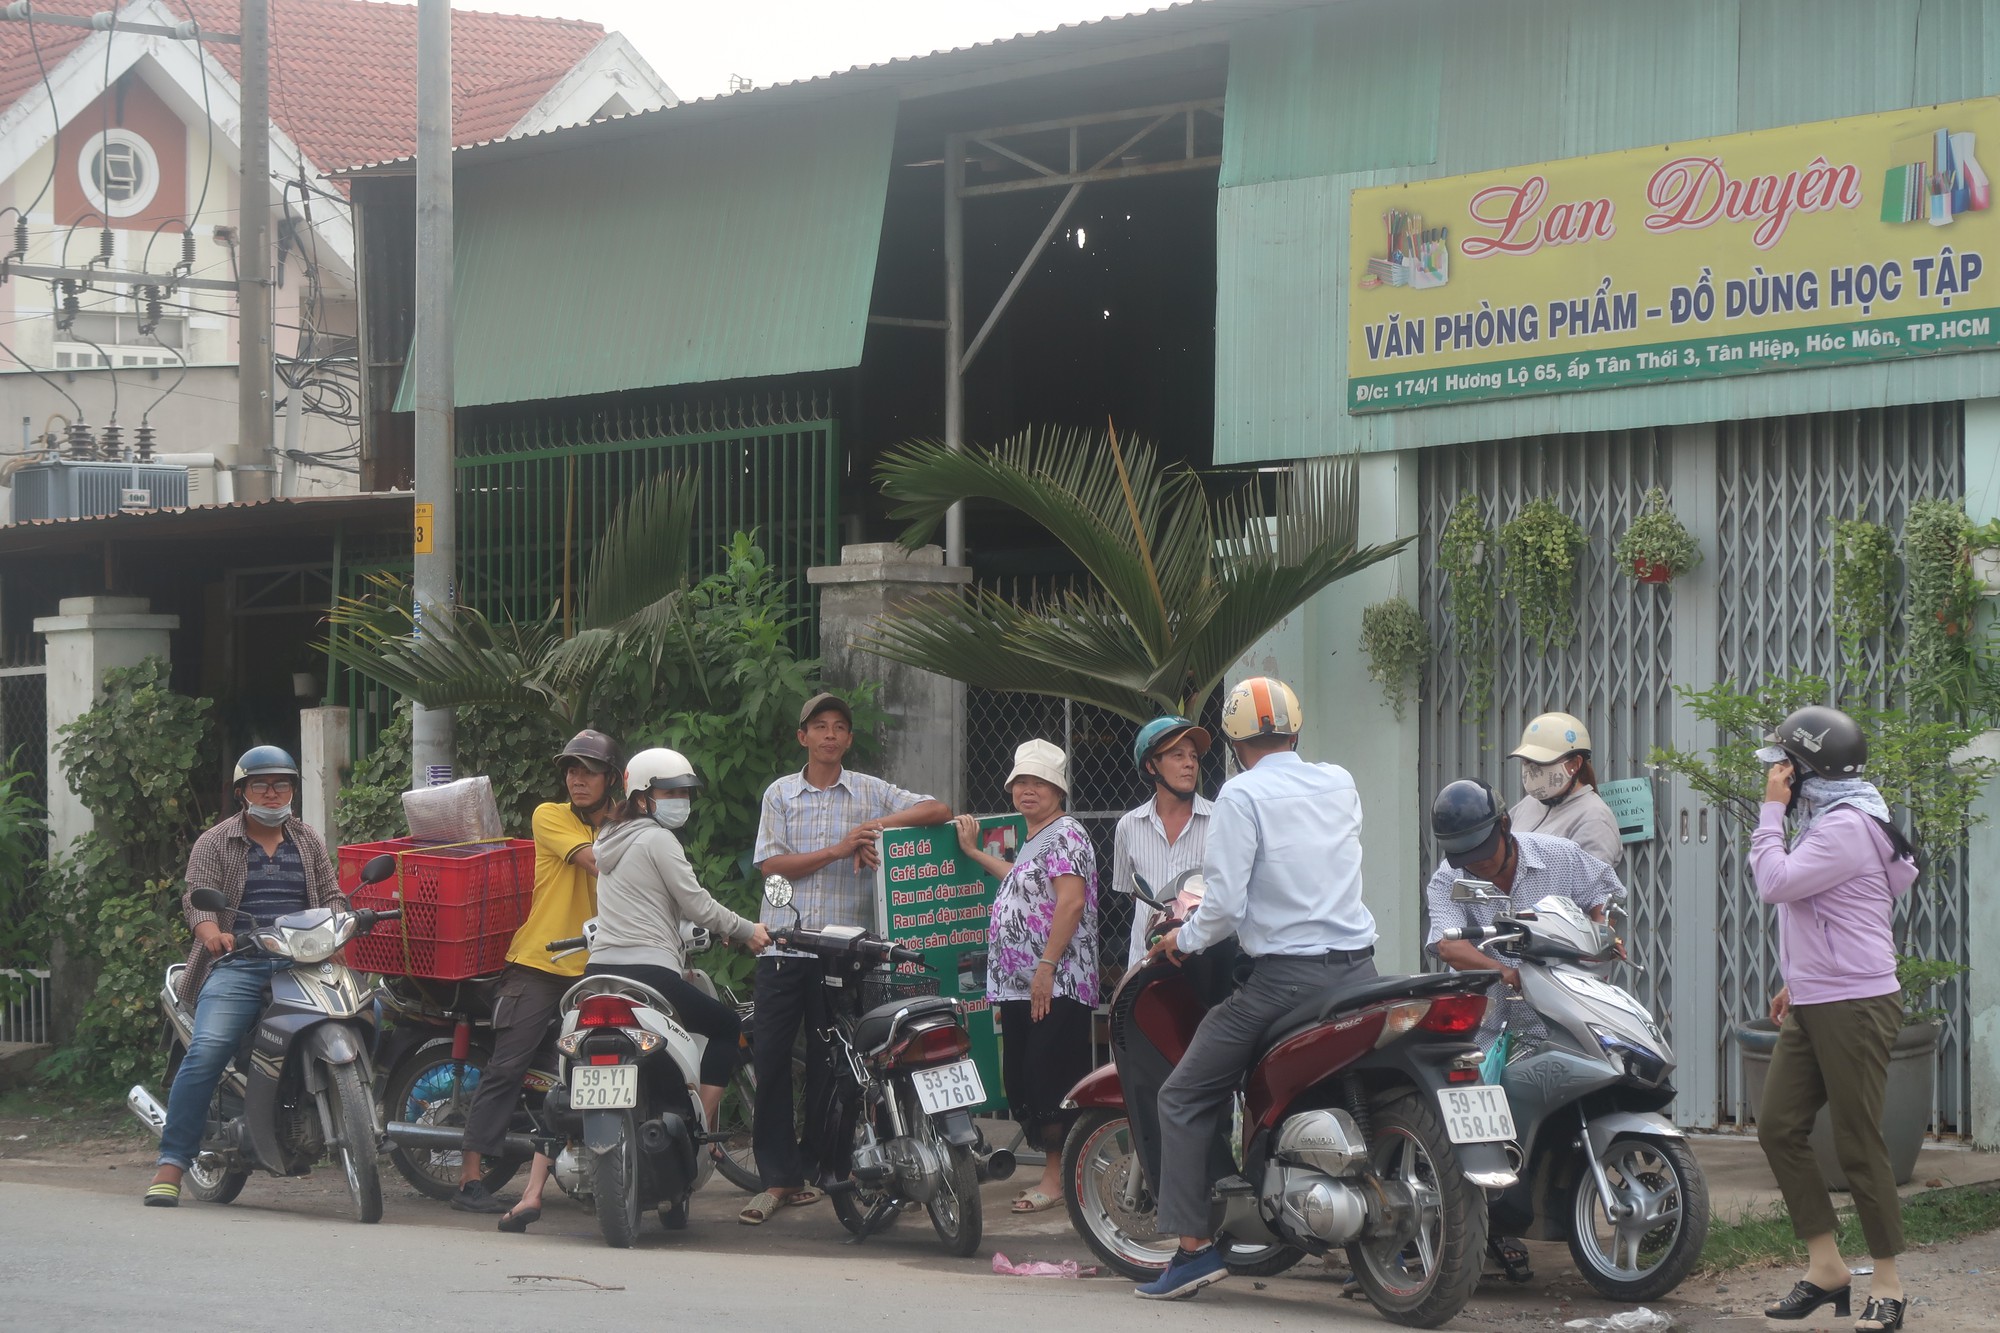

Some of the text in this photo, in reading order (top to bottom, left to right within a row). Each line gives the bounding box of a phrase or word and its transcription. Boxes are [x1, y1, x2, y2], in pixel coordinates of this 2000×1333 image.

[1461, 156, 1861, 258] Lan Duyên
[1365, 313, 1425, 360] VĂN
[1434, 300, 1538, 352] PHÒNG
[1548, 276, 1638, 338] PHẨM
[1670, 267, 1714, 325] ĐỒ
[1725, 266, 1820, 319] DÙNG
[1830, 261, 1902, 315] HỌC
[1912, 246, 1983, 307] TẬP
[1356, 317, 1990, 401] Đ/c: 174/1 Hương Lộ 65, ấp Tân Thới 3, Tân Hiệp, Hóc Môn, TP.HCM
[889, 839, 932, 858] Café đá
[890, 864, 916, 882] Café
[940, 859, 955, 875] đá
[892, 880, 985, 906] Rau má đậu xanh
[893, 913, 917, 930] Rau
[917, 909, 934, 927] má
[936, 907, 957, 926] đậu
[958, 903, 986, 921] xanh
[924, 931, 948, 949] sâm
[949, 928, 984, 946] đường
[261, 1028, 283, 1046] YAMAHA
[582, 1068, 627, 1087] 59-Y1
[922, 1065, 969, 1091] 53-S4
[575, 1087, 632, 1106] 520.74
[929, 1084, 976, 1109] 1760
[1448, 1090, 1497, 1115] 59-Y1
[1450, 1114, 1511, 1140] 158.48
